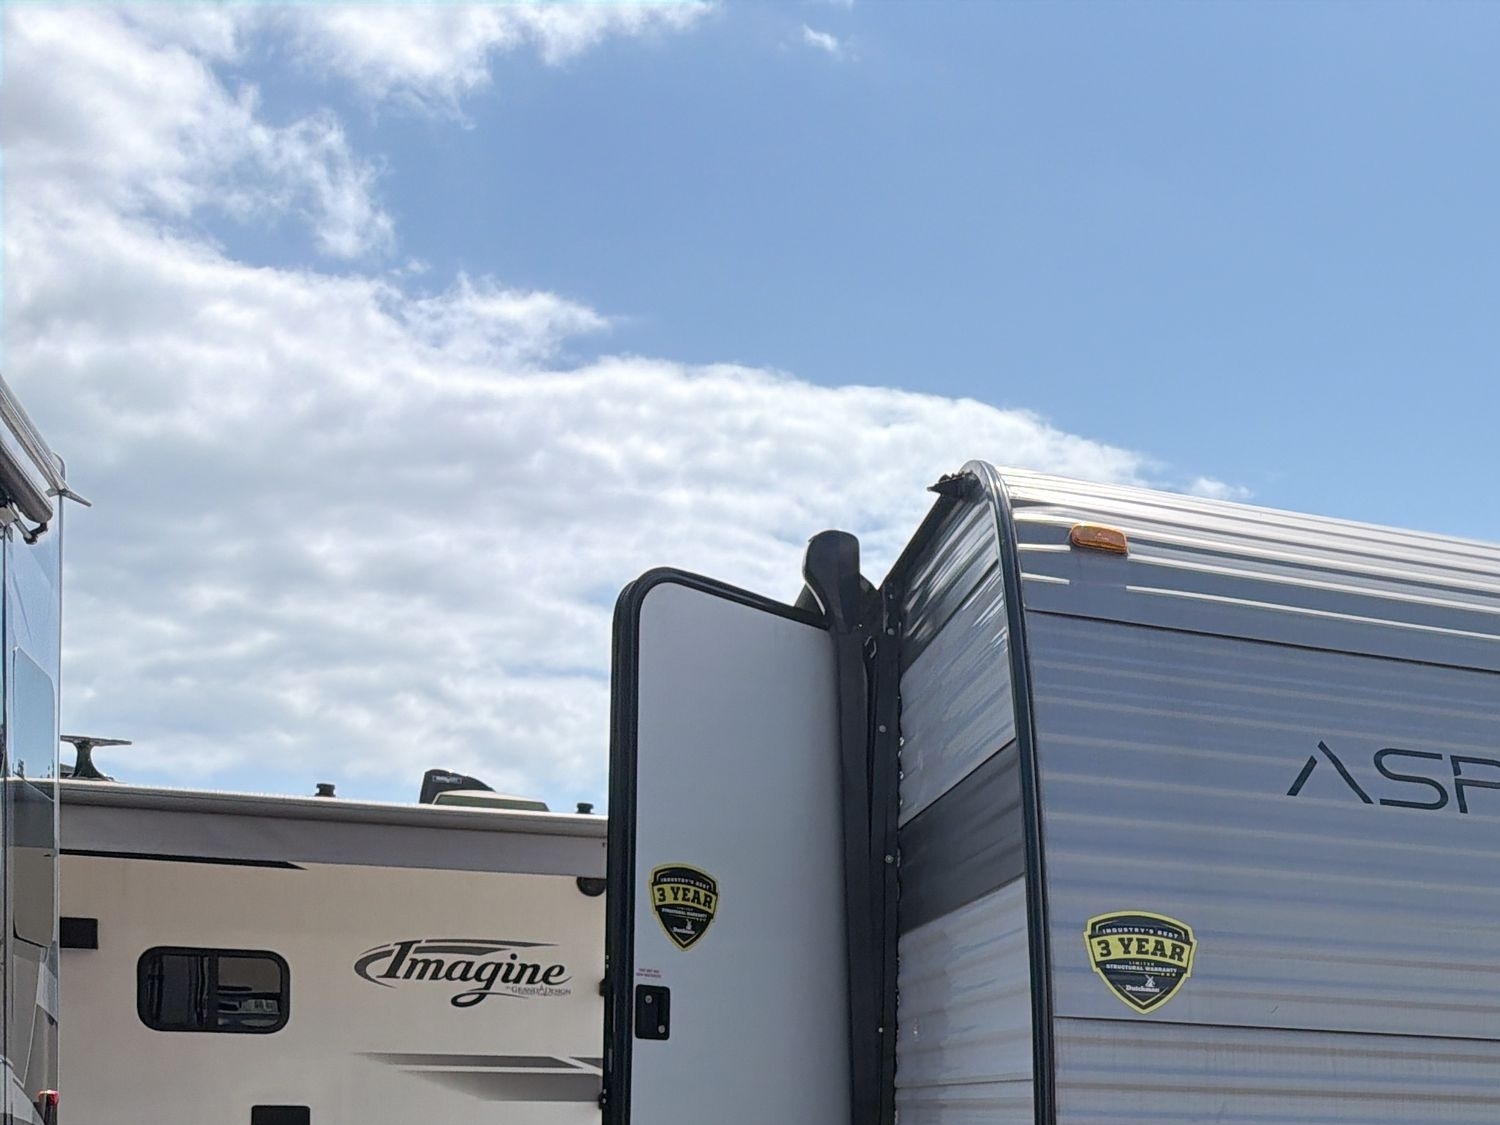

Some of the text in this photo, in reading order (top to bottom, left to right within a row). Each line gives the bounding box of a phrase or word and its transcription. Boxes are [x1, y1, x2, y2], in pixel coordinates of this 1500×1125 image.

[656, 886, 713, 909] 3 YEAR
[1096, 937, 1186, 963] 3 YEAR
[376, 939, 573, 1008] Imagine
